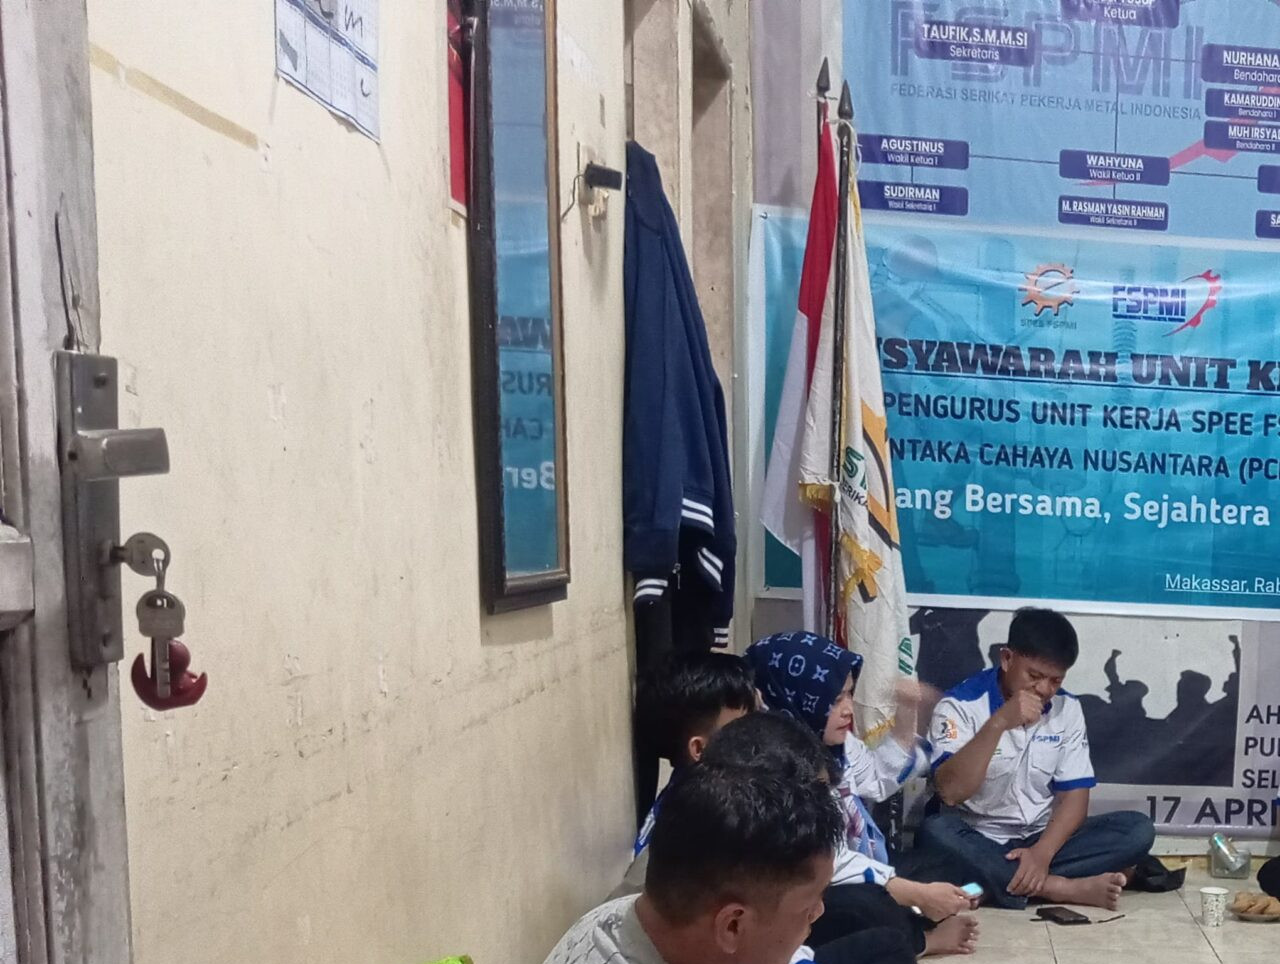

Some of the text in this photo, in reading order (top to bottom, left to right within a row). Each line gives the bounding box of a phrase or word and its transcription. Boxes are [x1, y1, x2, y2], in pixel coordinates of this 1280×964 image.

[1104, 6, 1137, 20] Ketua
[949, 45, 1000, 61] Sekretaris
[890, 83, 1202, 121] FEDERASI SERIKAT PEKERJA METAL INDONESIA
[1228, 125, 1250, 137] MUH
[881, 138, 944, 154] AGUSTINUS
[887, 153, 909, 164] Wakil
[910, 154, 934, 166] Ketua
[1087, 154, 1144, 170] WAHYUNA
[1090, 169, 1111, 180] Wakil
[1112, 170, 1134, 181] Ketua
[884, 185, 940, 201] SUDIRMAN
[1073, 201, 1106, 215] RASMAN
[1107, 203, 1131, 216] YASIN
[1131, 205, 1165, 219] RAHMAN
[1112, 285, 1187, 317] FSPMI
[877, 337, 1118, 384] SYAWARAH
[1131, 353, 1236, 390] UNIT
[883, 391, 1021, 423] PENGURUS
[1031, 400, 1093, 427] UNIT
[1102, 405, 1182, 433] KERJA
[1190, 410, 1254, 437] SPEE
[978, 442, 1074, 471] CAHAYA
[1083, 447, 1230, 479] NUSANTARA
[965, 483, 1112, 524] Bersama,
[1123, 491, 1271, 529] Sejahtera
[1164, 572, 1250, 594] Makassar,
[1146, 796, 1181, 823] 17
